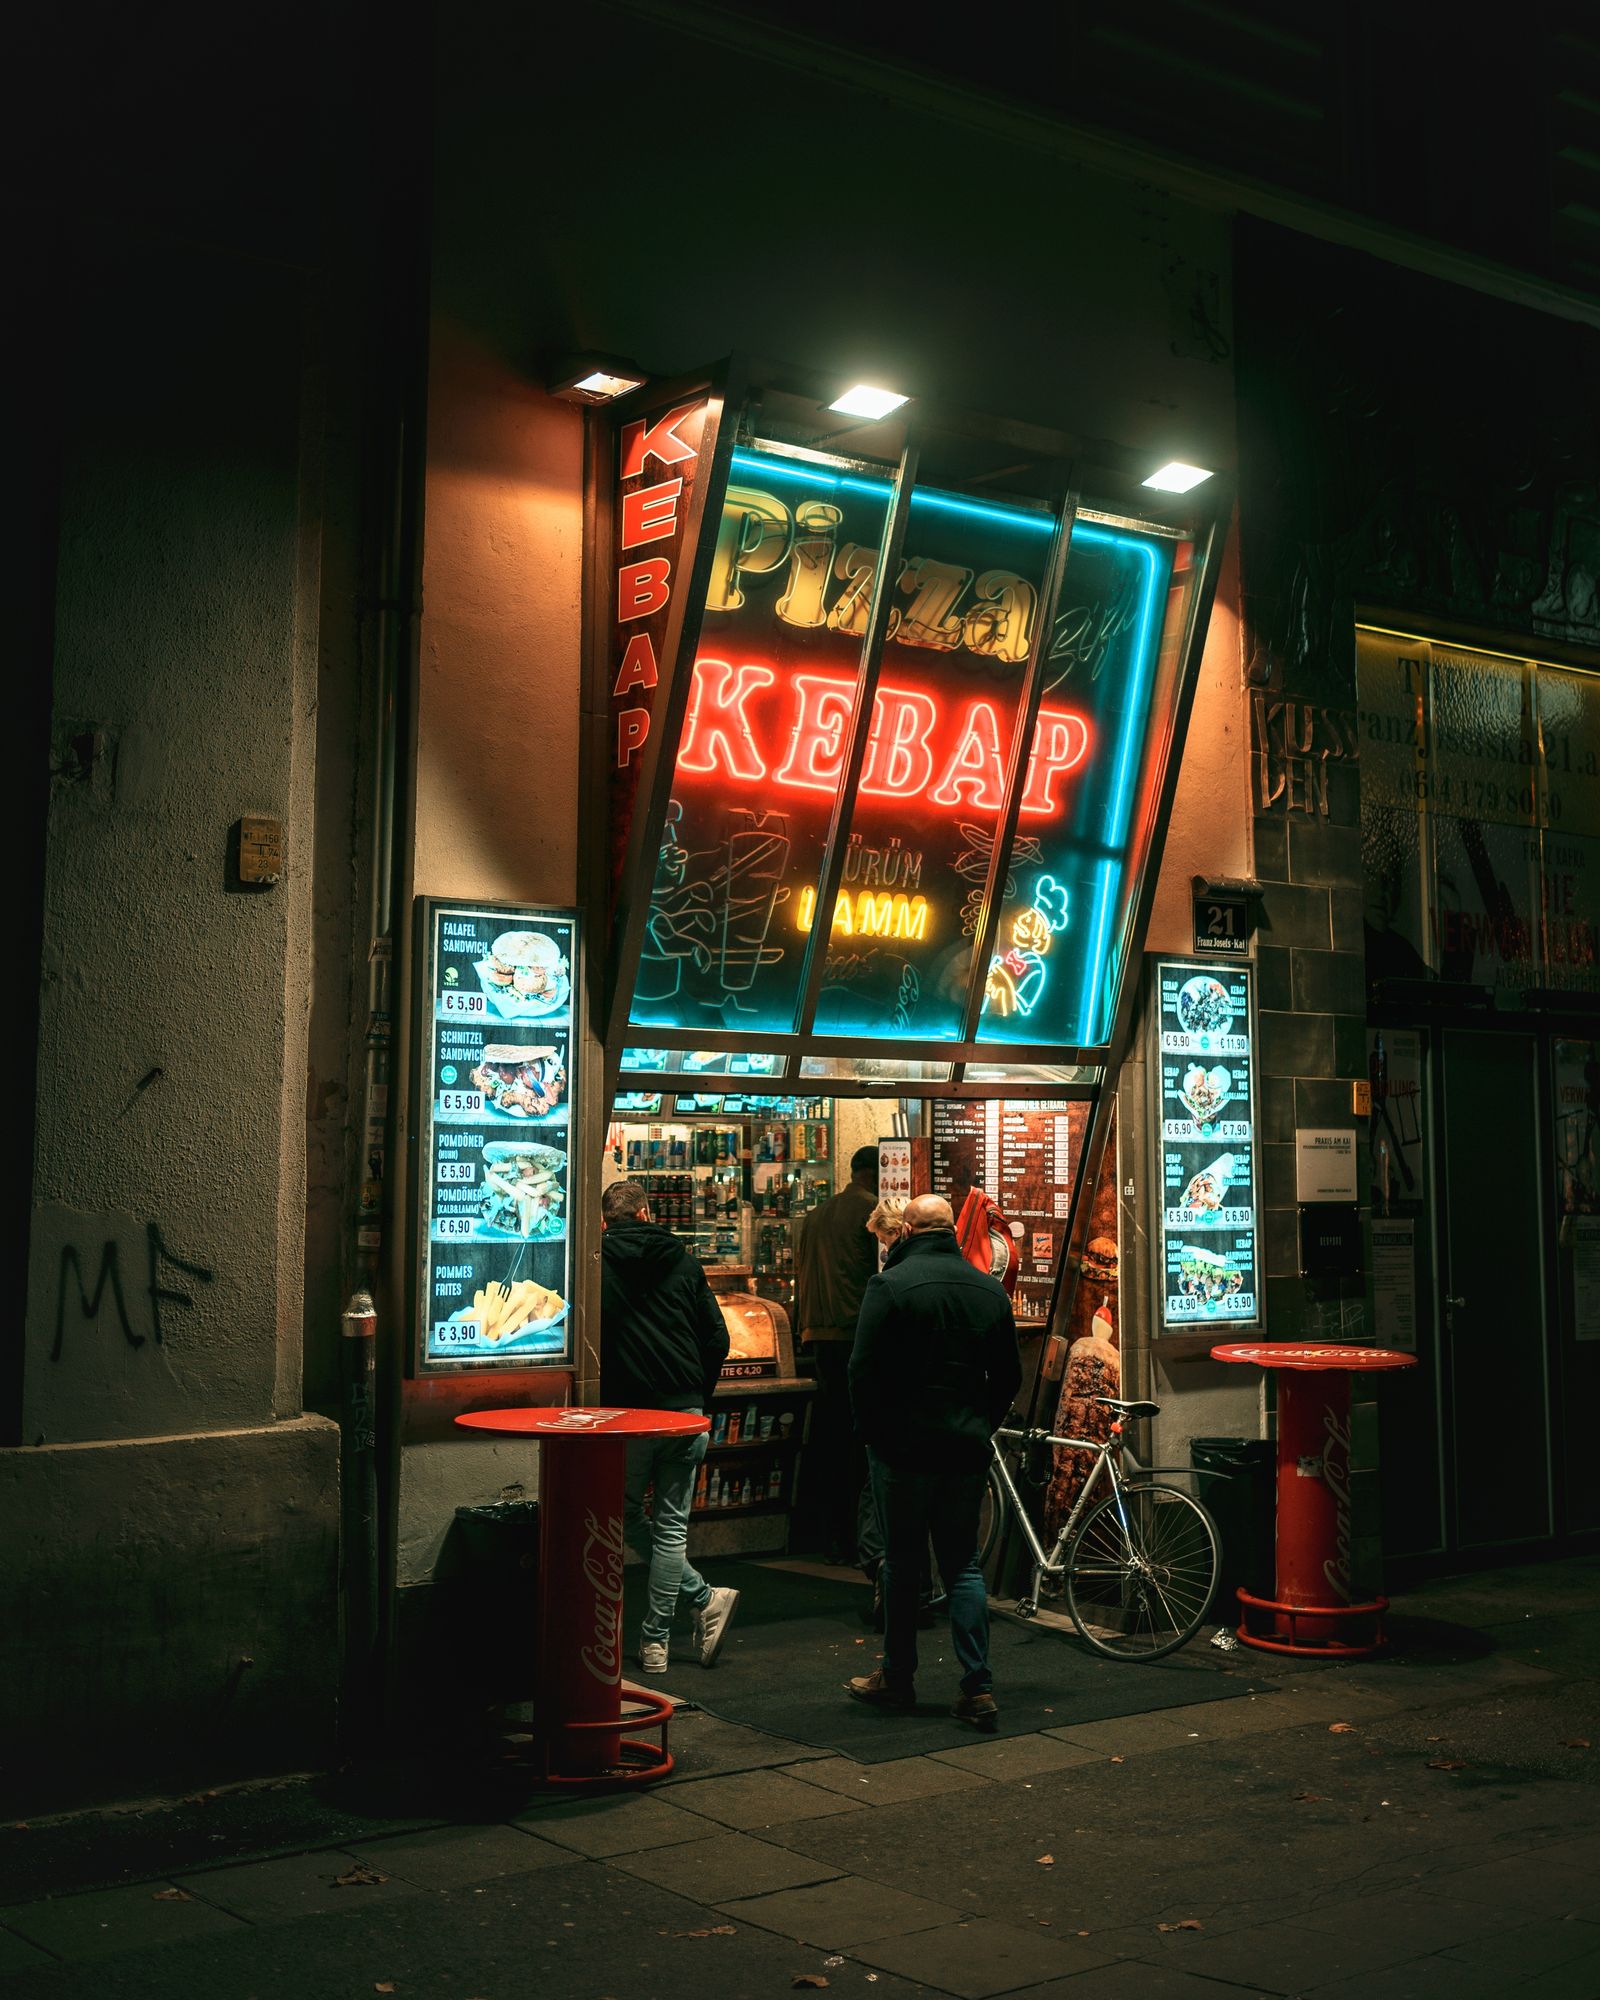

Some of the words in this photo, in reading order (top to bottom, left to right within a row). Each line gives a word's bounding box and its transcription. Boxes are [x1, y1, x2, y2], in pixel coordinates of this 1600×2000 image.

[613, 400, 702, 768] KEBAP
[677, 658, 1088, 814] KEBAP
[844, 833, 923, 888] ÜRÜM
[797, 884, 928, 940] LAMM
[1207, 906, 1234, 936] 21
[444, 922, 476, 937] FALAFEL
[443, 939, 488, 954] SANDWICH
[1197, 936, 1213, 947] Franz
[446, 996, 454, 1009] €
[457, 997, 483, 1012] 5,90
[441, 1031, 483, 1045] SCHNITZEL
[1166, 1035, 1171, 1047] €
[1220, 1037, 1225, 1049] €
[441, 1048, 485, 1062] SANDWICH
[444, 1095, 451, 1109] €
[455, 1096, 480, 1112] 5,90
[1167, 1123, 1172, 1134] €
[1222, 1124, 1227, 1136] €
[438, 1131, 484, 1148] POMDÖNER
[440, 1166, 447, 1178] €
[450, 1165, 471, 1180] 5,90
[437, 1186, 483, 1202] POMDÖNER
[1169, 1210, 1174, 1222] €
[1225, 1211, 1230, 1222] €
[440, 1220, 446, 1233] €
[448, 1219, 470, 1235] 6,90
[435, 1265, 473, 1279] POMMES
[435, 1282, 462, 1296] FRITES
[1171, 1299, 1176, 1311] €
[1227, 1297, 1232, 1309] €
[438, 1327, 446, 1342] €
[450, 1325, 476, 1343] 3,90
[736, 1367, 743, 1375] €
[744, 1366, 762, 1376] 4,20
[581, 1505, 623, 1685] Coca-Cola
